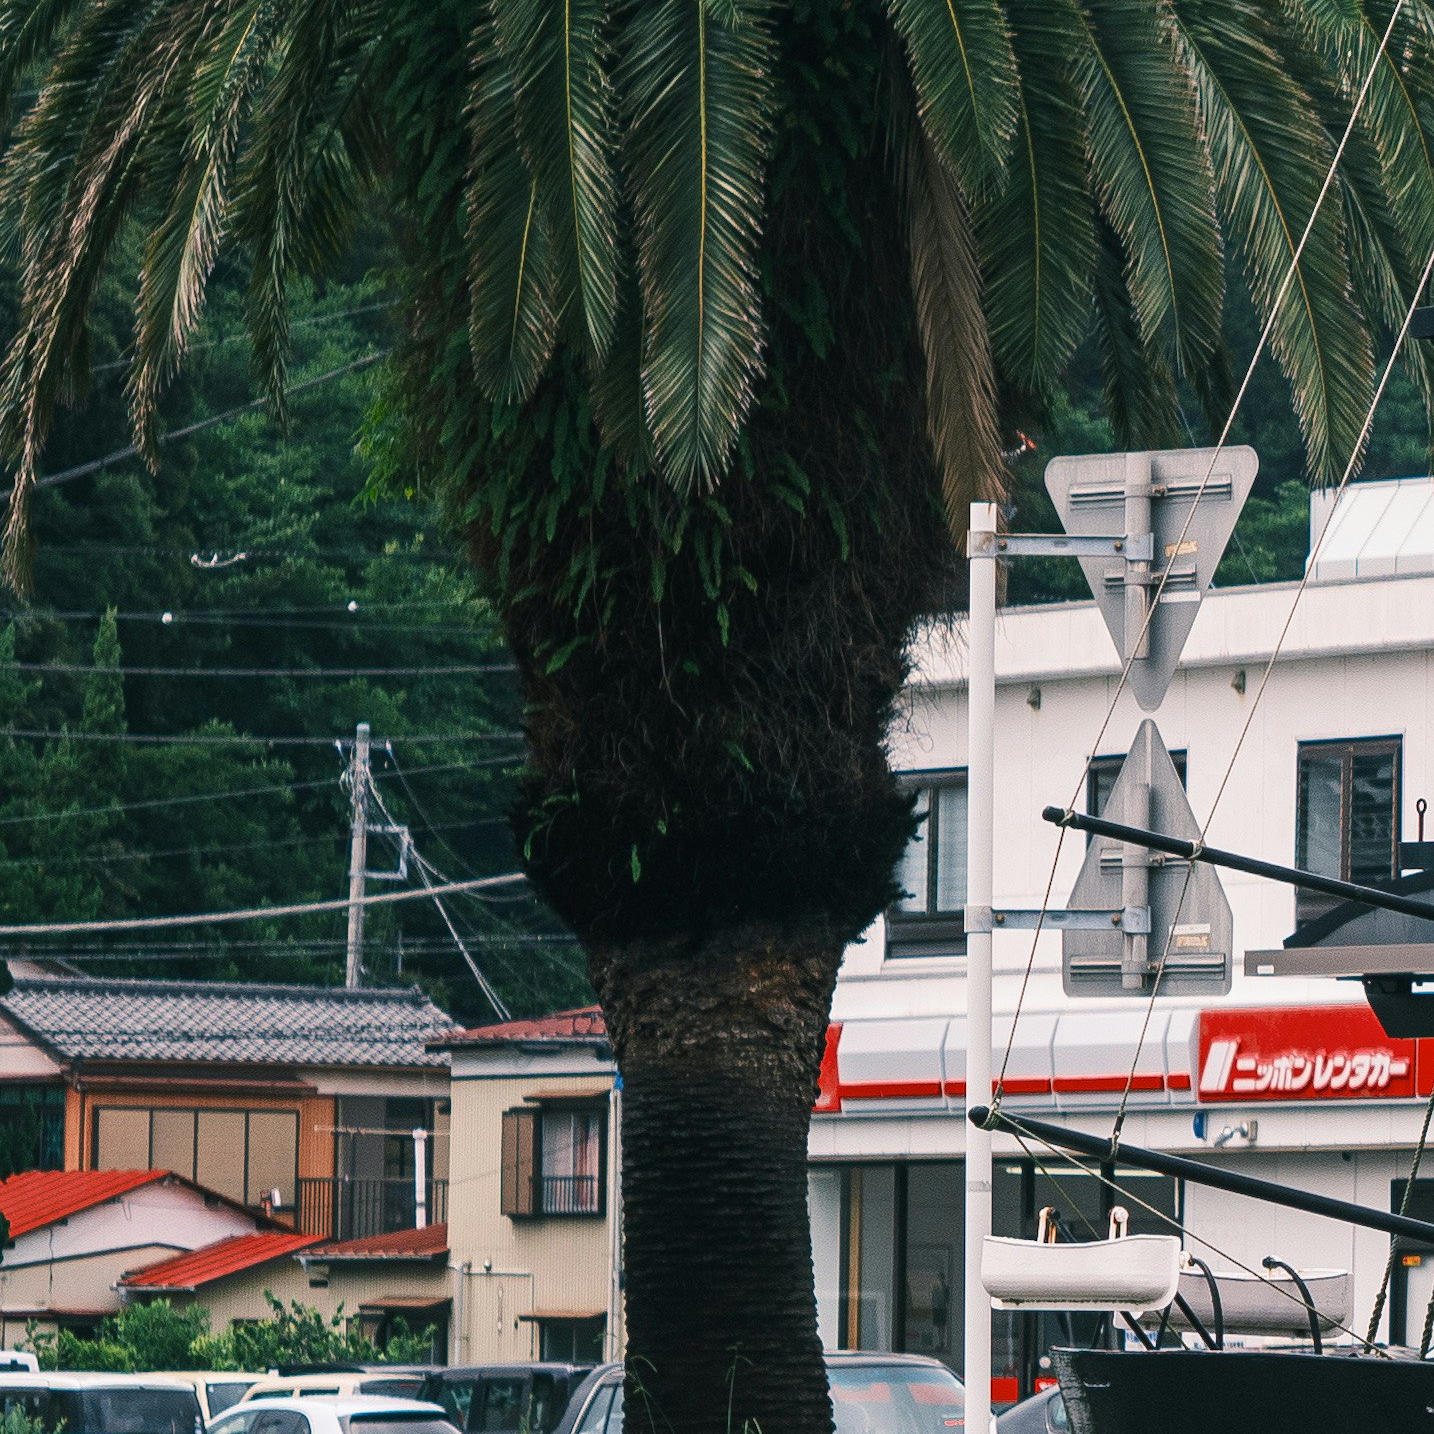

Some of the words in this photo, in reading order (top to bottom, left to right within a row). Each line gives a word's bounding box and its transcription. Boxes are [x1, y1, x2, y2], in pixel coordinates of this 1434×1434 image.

[1233, 1052, 1407, 1092] ニッポンレンタカー
